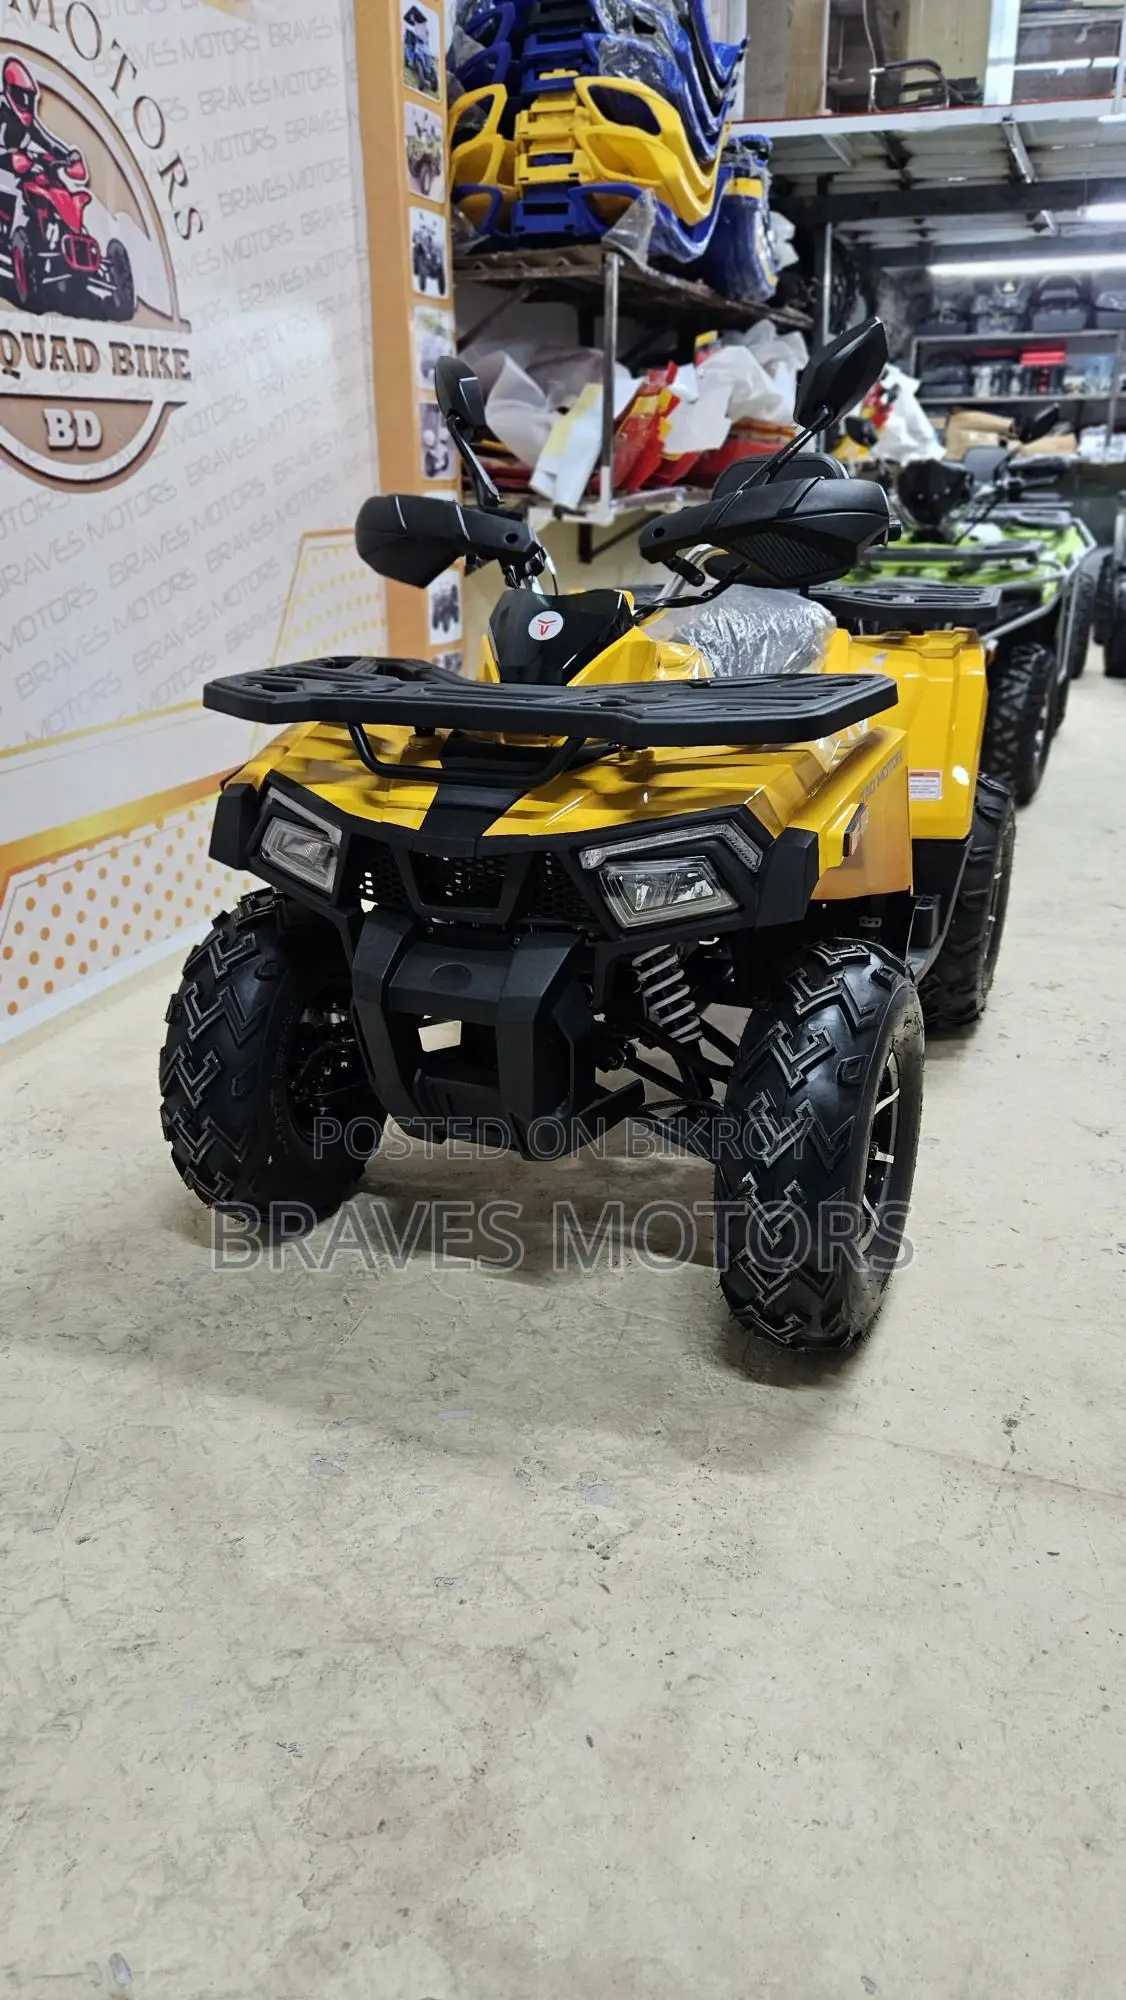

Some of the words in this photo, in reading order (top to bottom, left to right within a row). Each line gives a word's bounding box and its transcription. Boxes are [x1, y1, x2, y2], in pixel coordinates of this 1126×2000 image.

[180, 27, 260, 62] MOTORS
[268, 15, 332, 48] BRAVES
[198, 79, 270, 116] BRAVES
[273, 65, 339, 99] MOTORS
[8, 0, 204, 241] MOTORS
[200, 125, 277, 168] MOTORS
[285, 109, 346, 144] BRAVES
[217, 174, 288, 218] BRAVES
[220, 220, 294, 267] MOTORS
[237, 268, 305, 313] BRAVES
[0, 328, 100, 380] QUAD
[108, 340, 193, 382] BIKE
[42, 408, 104, 450] BD
[171, 391, 248, 450] MOTORS
[86, 478, 178, 543] MOTORS
[184, 431, 258, 488] BRAVES
[0, 489, 71, 541] TORS
[107, 522, 191, 590] BRAVES
[191, 475, 266, 537] MOTORS
[14, 624, 112, 702] BRAVES
[111, 565, 198, 635] MOTORS
[205, 512, 275, 575] BRAVES
[24, 670, 123, 745] MOTORS
[131, 606, 212, 677] BRAVES
[210, 555, 282, 622] MOTORS
